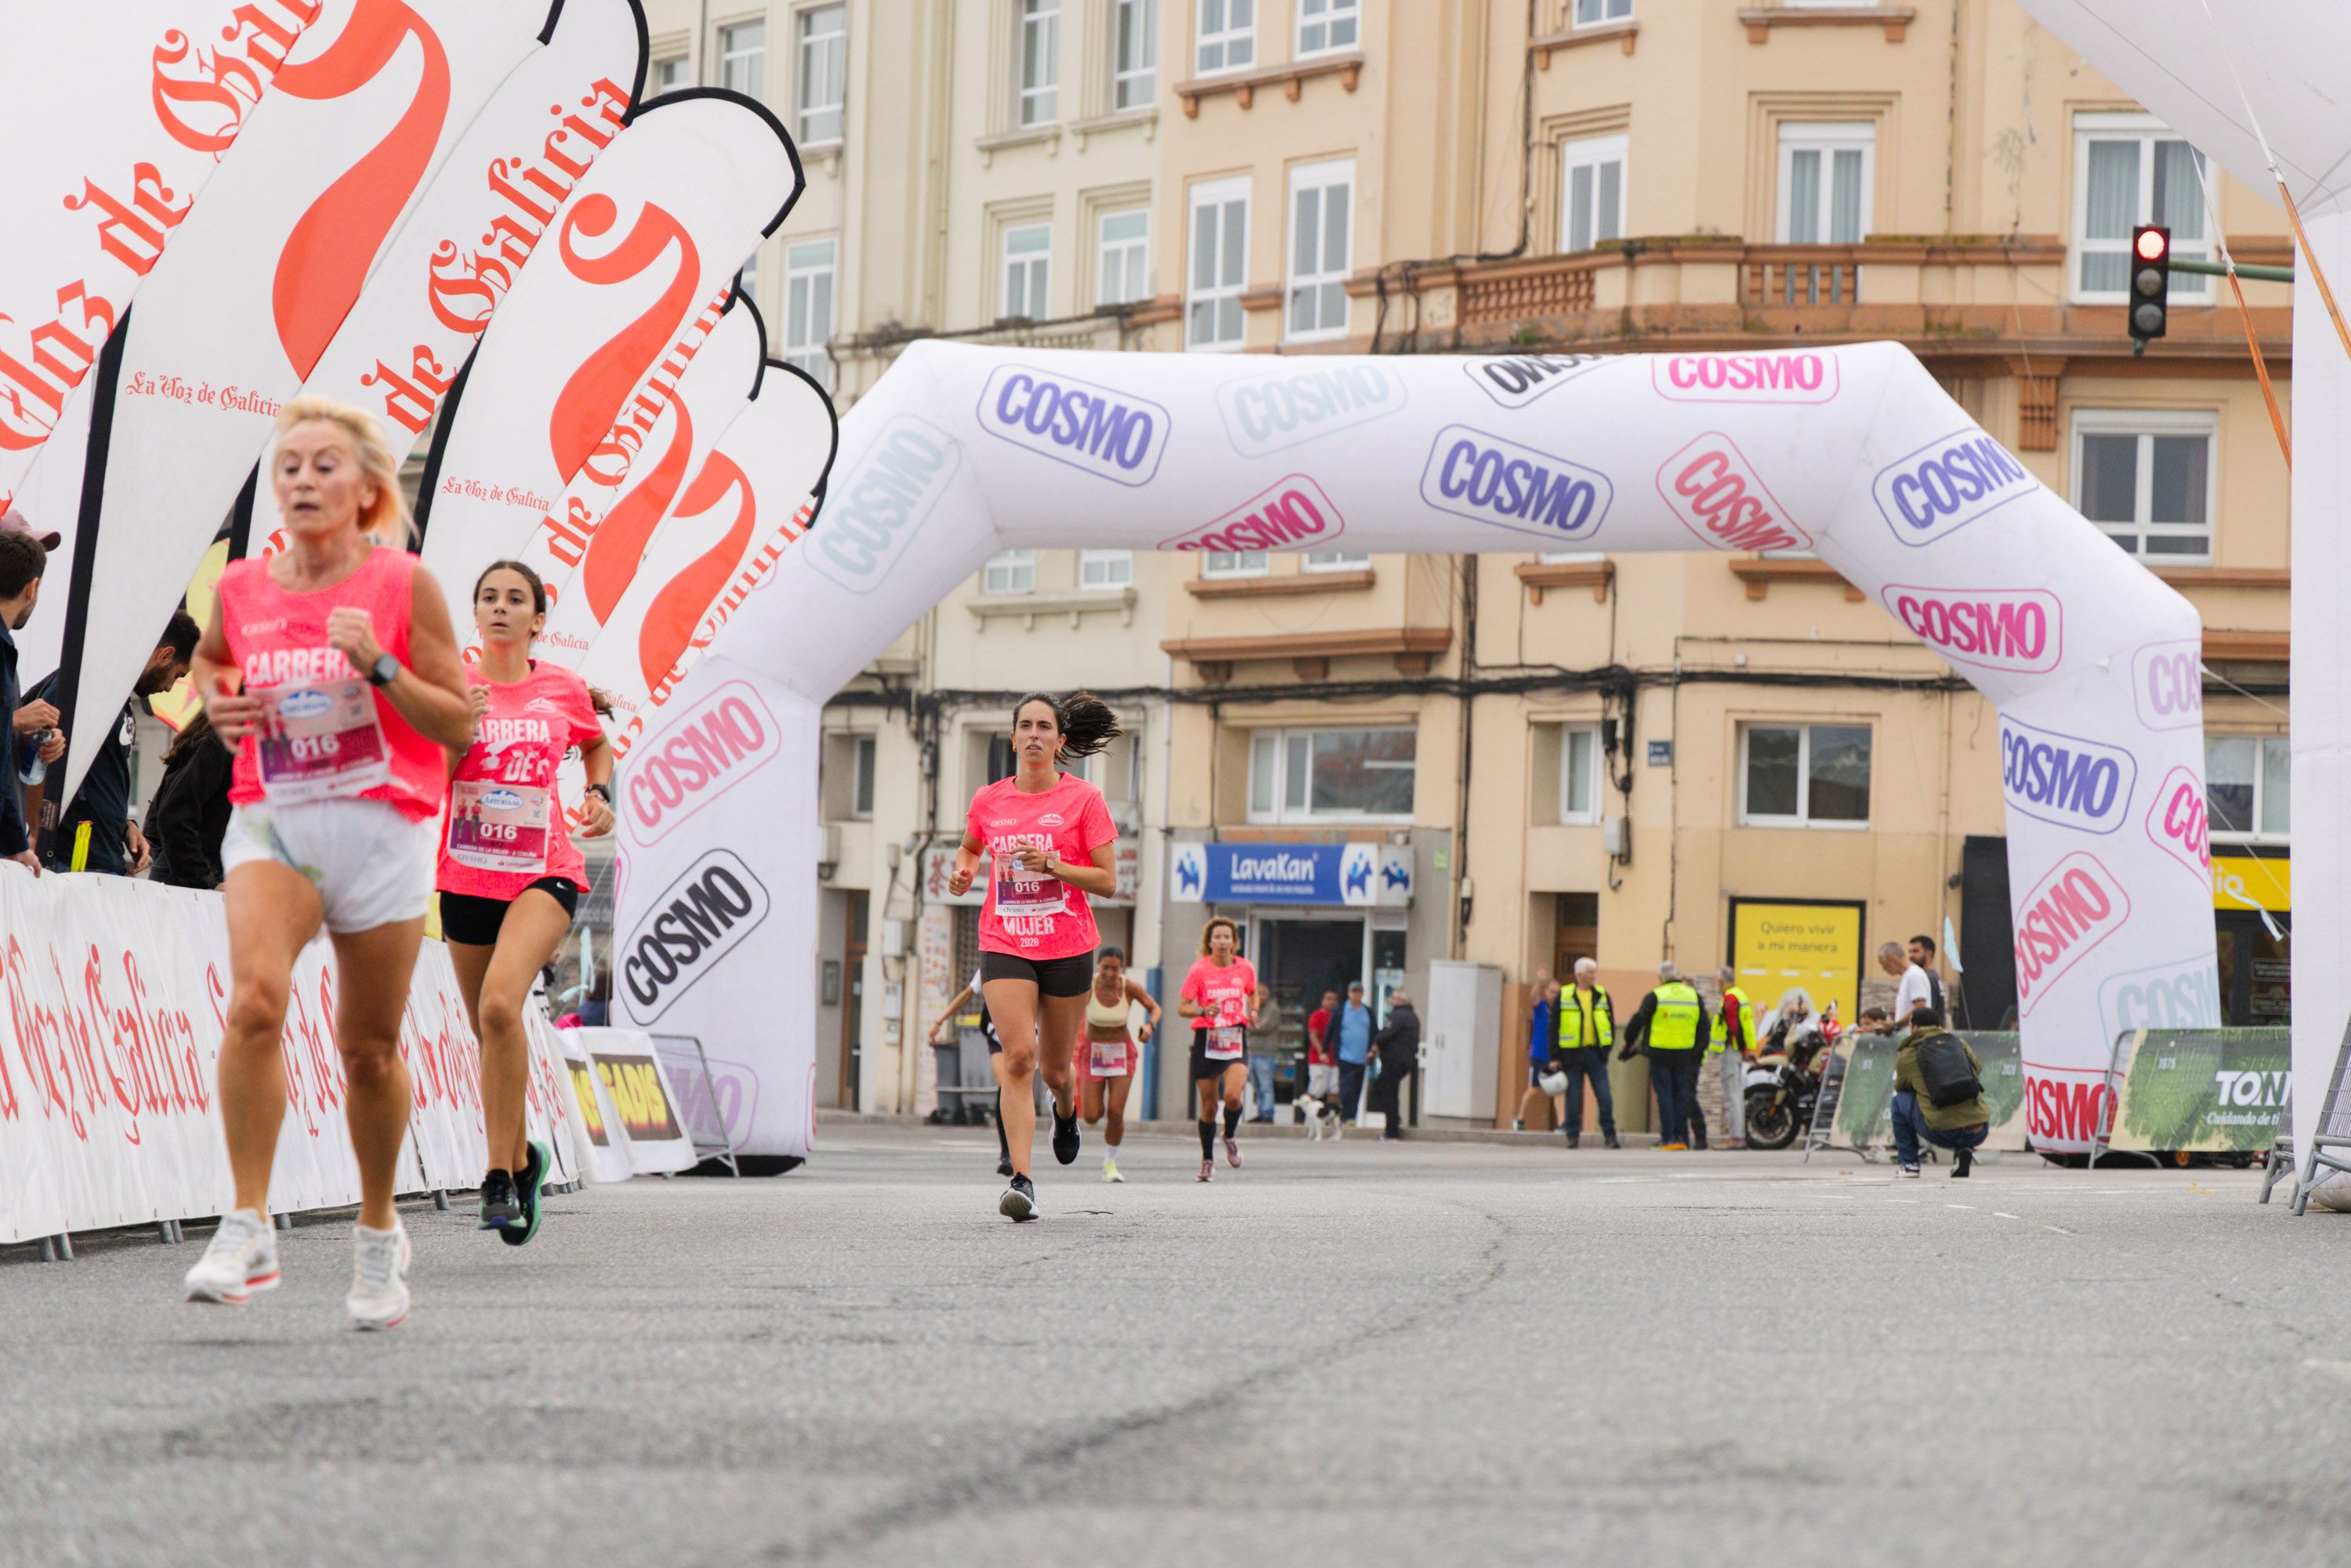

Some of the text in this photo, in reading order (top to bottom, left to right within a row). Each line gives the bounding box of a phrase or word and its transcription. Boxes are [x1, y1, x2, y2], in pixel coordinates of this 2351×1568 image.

[63, 162, 194, 277] de
[126, 371, 155, 395] La
[160, 375, 194, 404] Voz
[197, 382, 216, 404] de
[360, 344, 458, 434] de
[1668, 354, 1824, 390] COSMO
[1233, 364, 1390, 442] COSMO
[996, 373, 1153, 470] COSMO
[441, 476, 549, 511] La Voz de Galicia
[820, 429, 942, 575] COSMO
[1440, 440, 1596, 531] COSMO
[550, 633, 589, 650] Galicia
[1897, 596, 2046, 660] COSMO
[291, 733, 340, 759] 016
[473, 719, 551, 744] ARRERA
[629, 696, 766, 827] COSMO
[2002, 727, 2119, 819] COSMO
[480, 824, 517, 840] 016
[991, 818, 1017, 827] OYSHO
[992, 833, 1054, 853] CARERA
[1230, 853, 1315, 881] LavaKan
[1014, 882, 1040, 893] 016
[625, 866, 752, 1006] COSMO
[1003, 916, 1055, 936] MUJER
[1020, 938, 1039, 947] 2026
[1760, 921, 1836, 936] Quiero vivir
[1758, 941, 1838, 953] a mi manera
[2023, 1077, 2118, 1142] OSMO
